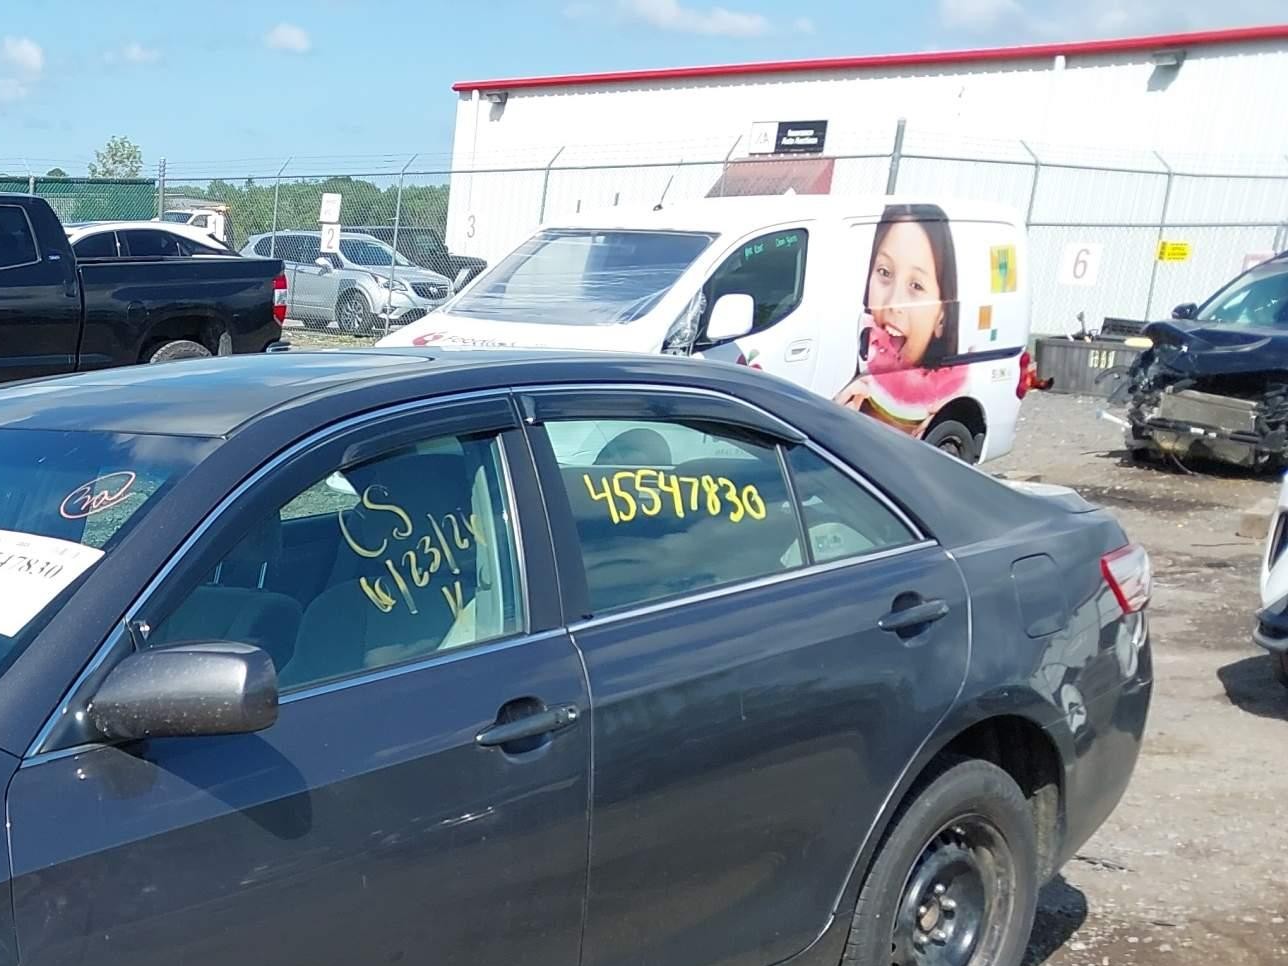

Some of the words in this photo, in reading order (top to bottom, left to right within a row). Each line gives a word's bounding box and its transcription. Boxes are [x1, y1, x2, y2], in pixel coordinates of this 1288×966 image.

[326, 228, 335, 250] 2
[466, 214, 476, 239] 3
[1073, 248, 1090, 279] 6
[583, 469, 767, 524] 45547830
